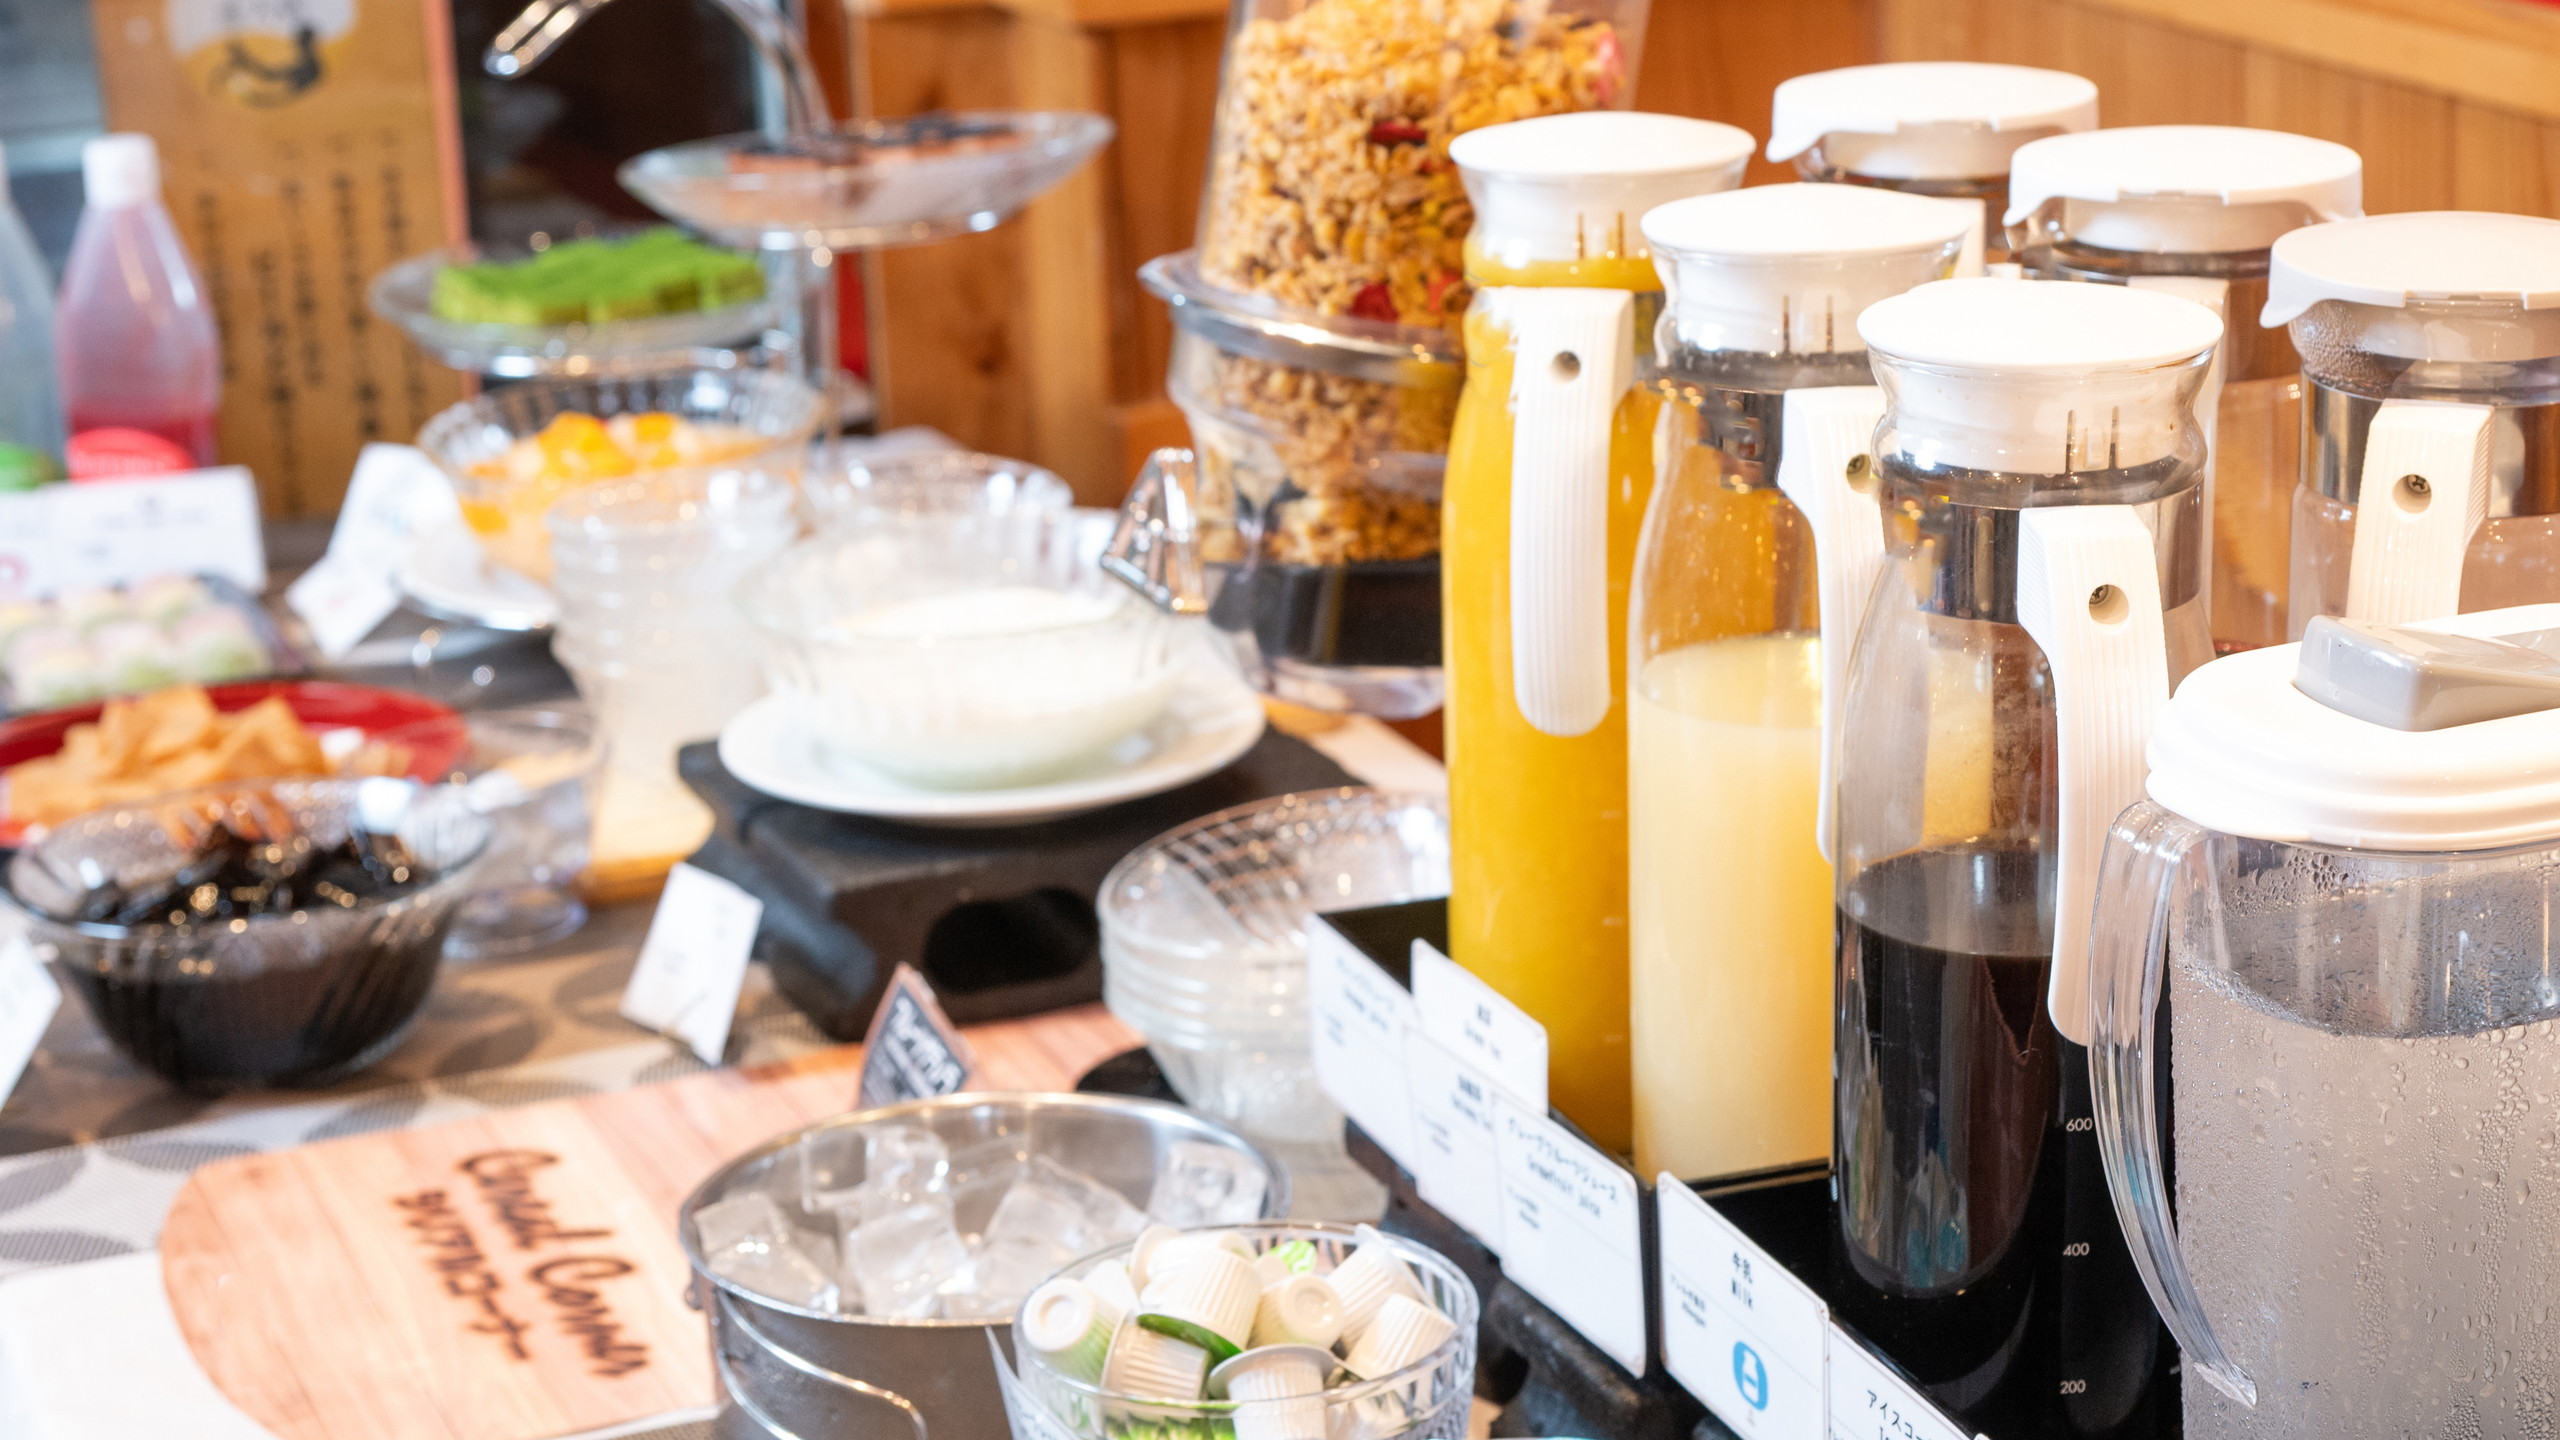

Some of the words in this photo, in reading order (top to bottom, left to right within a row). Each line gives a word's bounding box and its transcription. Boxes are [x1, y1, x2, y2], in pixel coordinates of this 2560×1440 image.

[2065, 1117, 2093, 1132] 600
[2062, 1242, 2090, 1256] 400
[1732, 1252, 1754, 1285] 牛乳
[1731, 1278, 1753, 1309] Milk
[2058, 1379, 2087, 1394] 200
